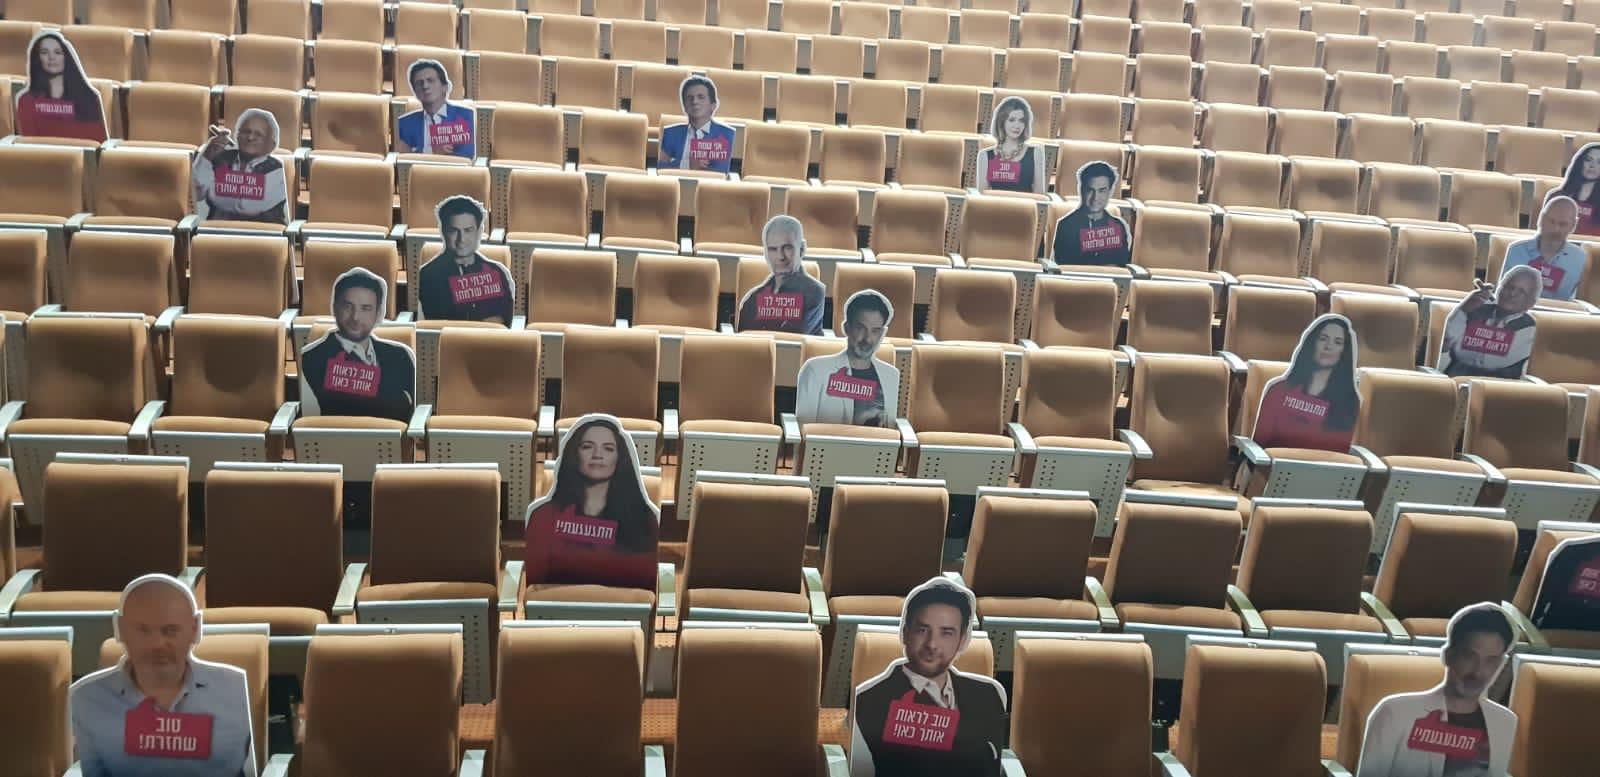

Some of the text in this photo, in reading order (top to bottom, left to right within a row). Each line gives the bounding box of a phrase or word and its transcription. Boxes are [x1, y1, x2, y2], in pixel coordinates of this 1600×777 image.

[246, 176, 257, 185] אני
[239, 185, 263, 197] לראות
[482, 282, 501, 295] שנה
[784, 307, 801, 318] שנה
[333, 364, 374, 380] טוב לראות
[353, 378, 372, 390] אותך
[828, 379, 873, 397] התגעגעתי!
[1283, 395, 1326, 417] התגעגעתי!
[555, 519, 613, 539] התגעגעתי!
[155, 717, 181, 733] טוב
[895, 708, 951, 729] טוב לראות
[893, 723, 945, 744] אותך כאן!
[1411, 727, 1476, 750] התגעגעתי!
[139, 734, 197, 752] שחזרת!
